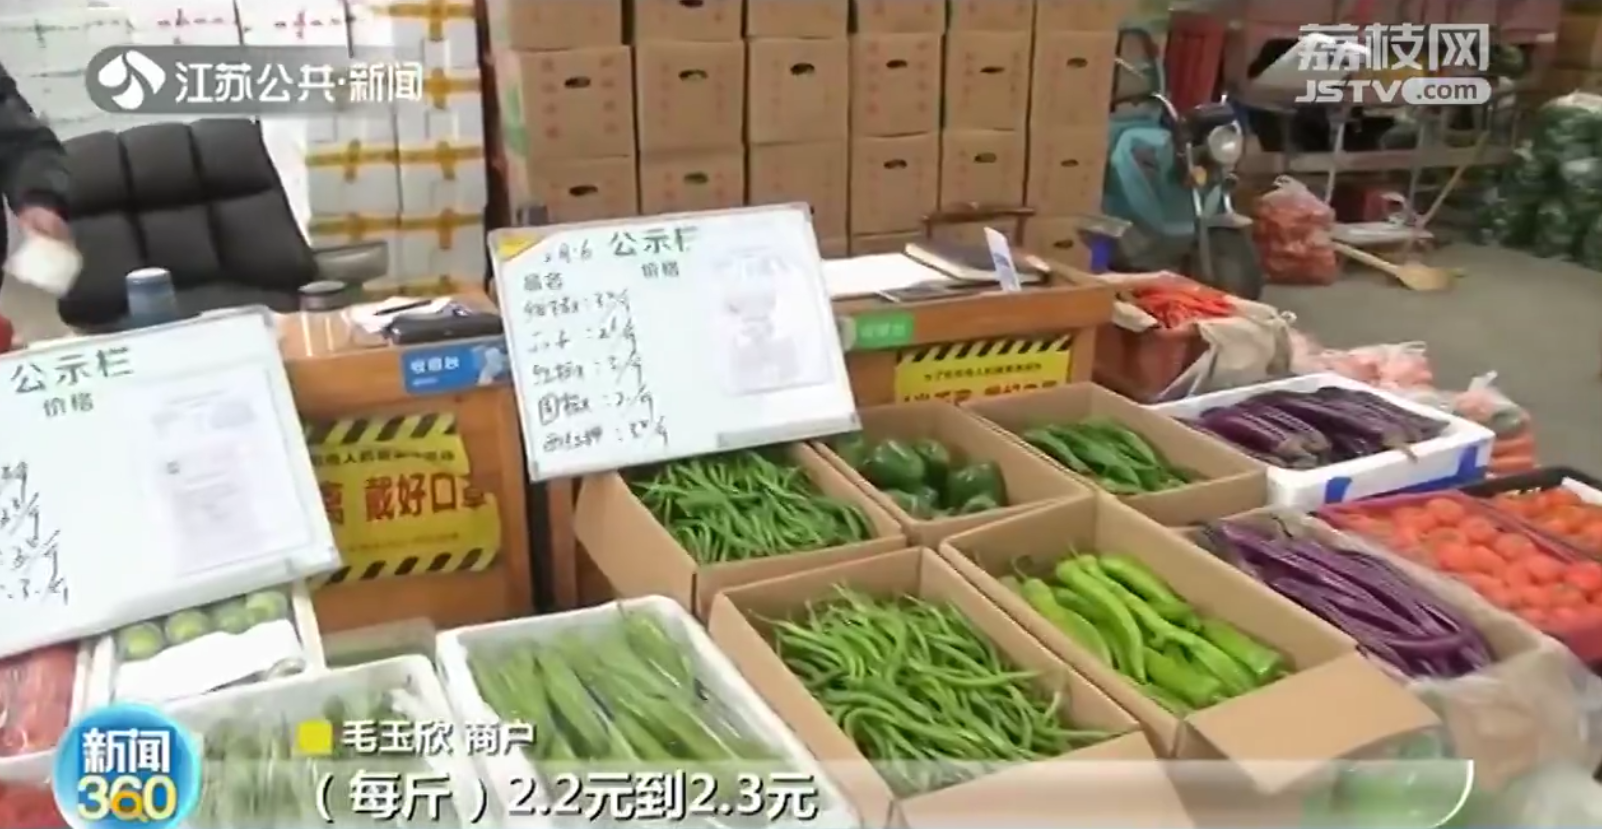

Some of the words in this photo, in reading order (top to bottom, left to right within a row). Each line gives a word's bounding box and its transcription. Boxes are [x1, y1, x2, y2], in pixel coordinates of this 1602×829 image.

[11, 346, 134, 394] 公示栏
[43, 392, 95, 418] 价格
